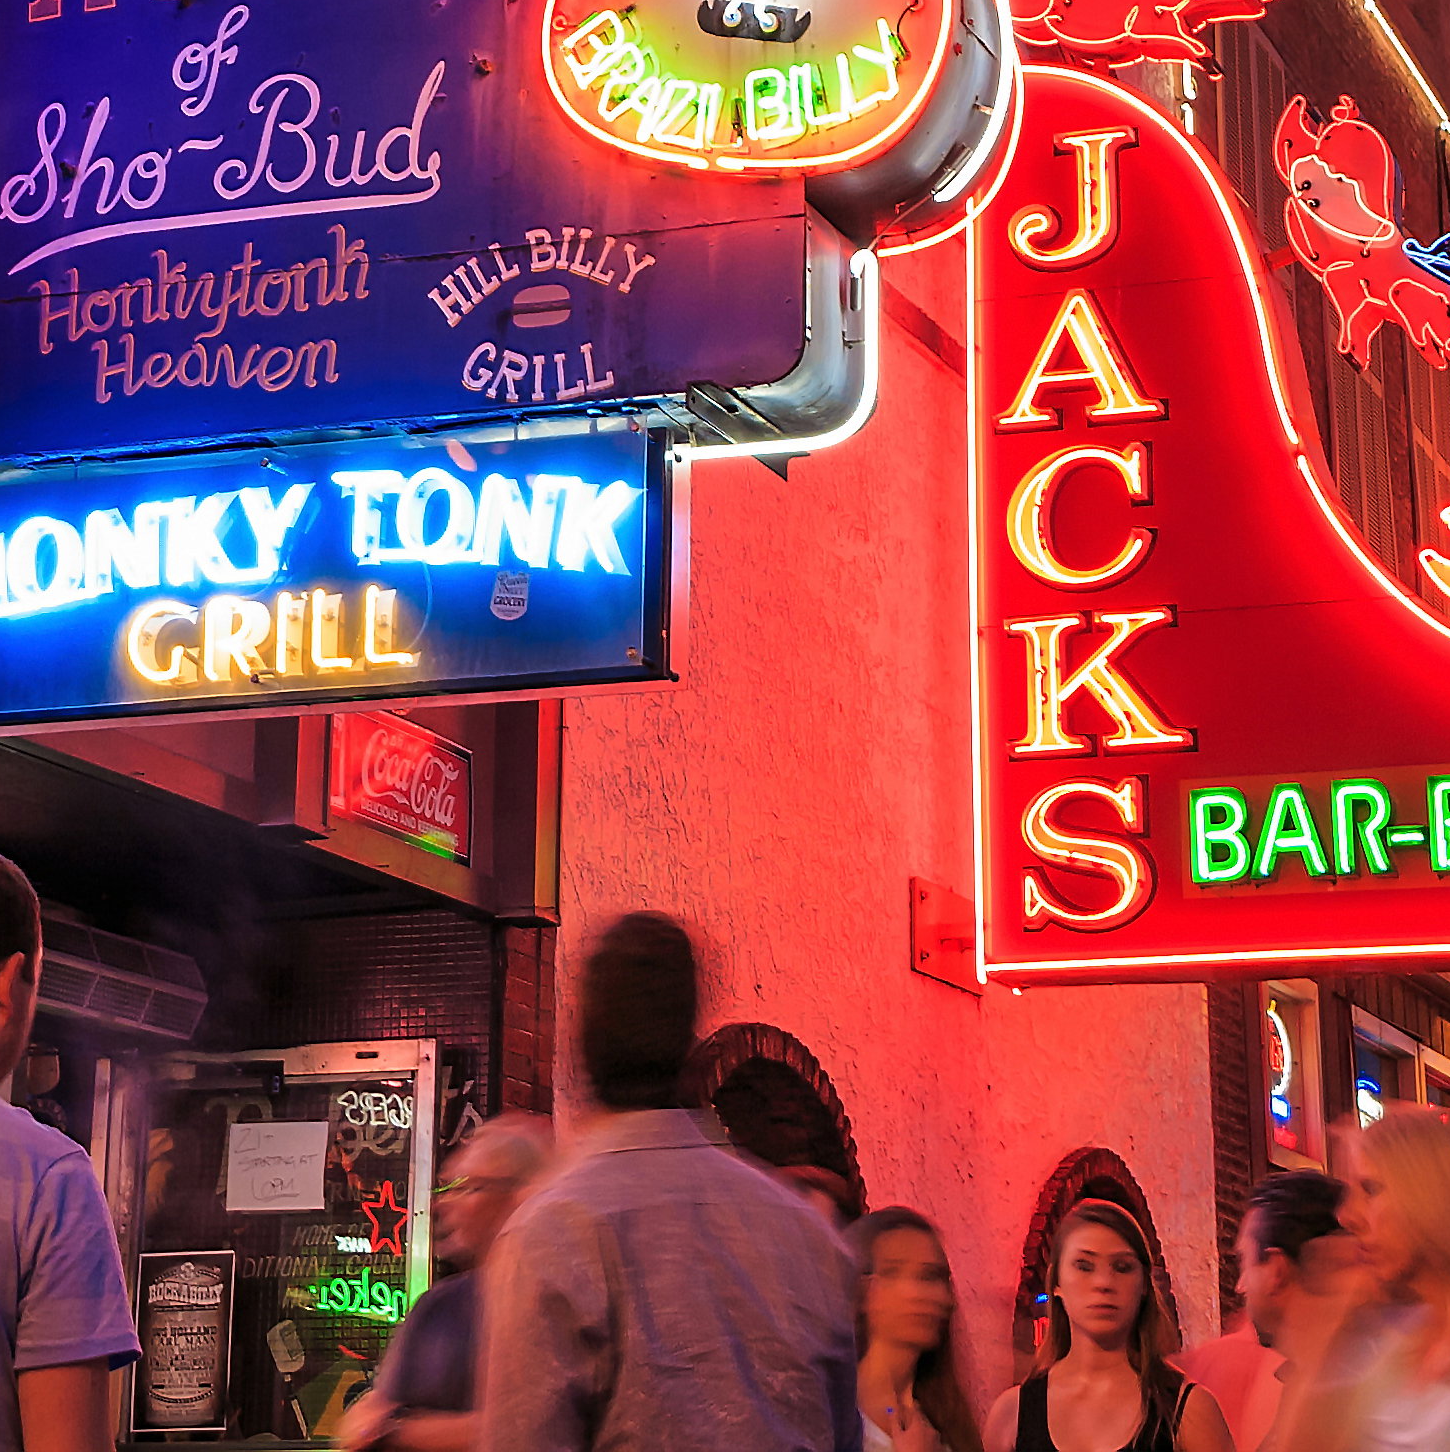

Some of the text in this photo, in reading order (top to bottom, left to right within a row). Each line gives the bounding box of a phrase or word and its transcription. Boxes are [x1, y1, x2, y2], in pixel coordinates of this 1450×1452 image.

[172, 4, 250, 116] of
[37, 224, 370, 355] Honkytonk
[426, 225, 655, 328] HILL BILLY
[93, 335, 340, 405] Heaven
[460, 341, 615, 404] GRILL
[332, 466, 647, 576] TONK
[992, 123, 1199, 933] JACKS
[125, 584, 422, 687] GRILL
[361, 728, 460, 828] Coca-Cola
